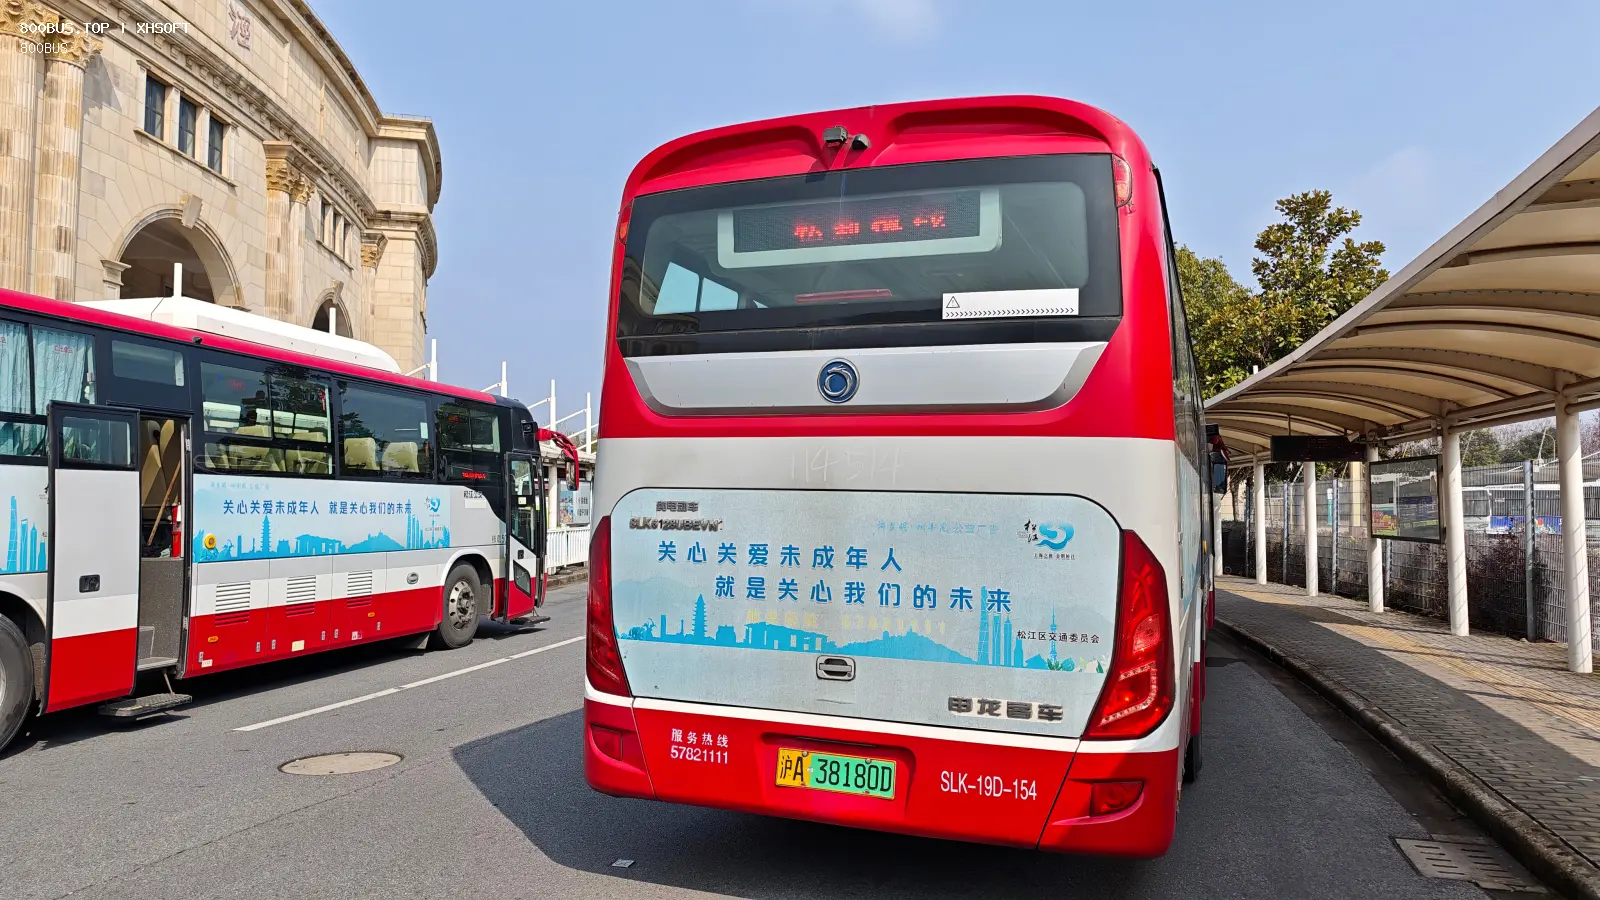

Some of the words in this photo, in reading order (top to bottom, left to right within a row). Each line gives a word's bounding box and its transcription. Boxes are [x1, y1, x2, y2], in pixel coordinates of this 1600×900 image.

[223, 499, 320, 515] 关心关爱未成年人
[328, 499, 413, 515] 就是关心我们的未来
[657, 541, 903, 572] 关心关爱未成年人
[715, 575, 1013, 613] 就是关心我们的未来
[1017, 630, 1100, 643] 松江区交通委员会
[671, 728, 729, 748] 服务热线
[670, 745, 728, 764] 57821111
[940, 770, 1038, 801] SLK-19D-154
